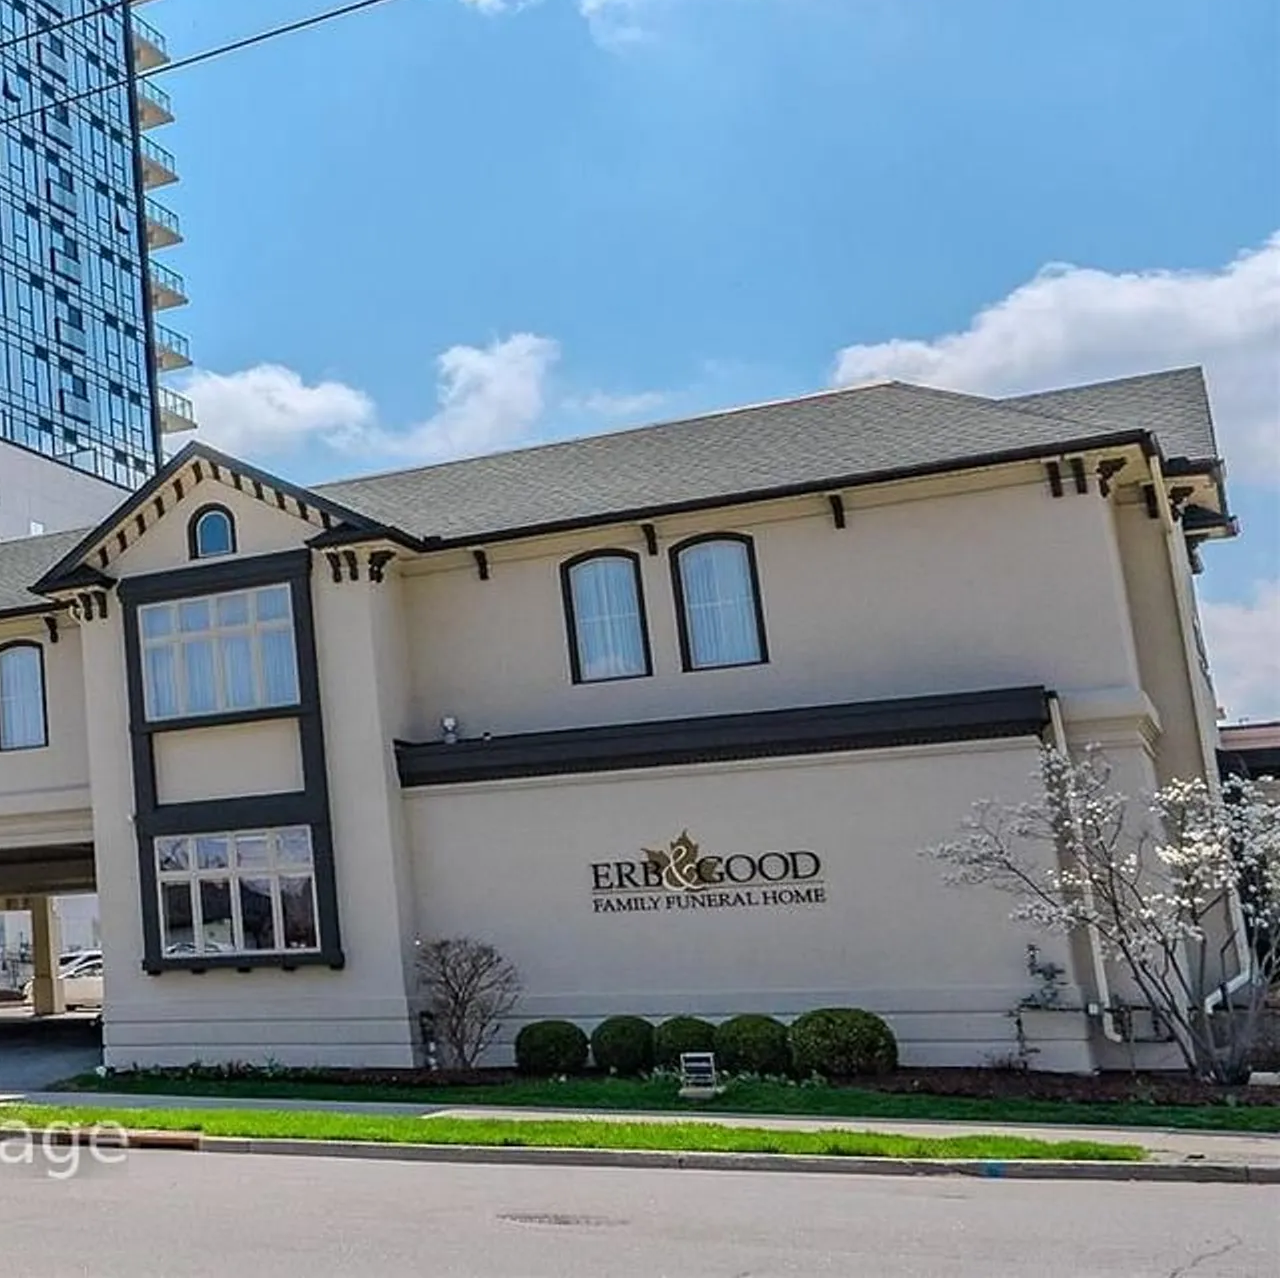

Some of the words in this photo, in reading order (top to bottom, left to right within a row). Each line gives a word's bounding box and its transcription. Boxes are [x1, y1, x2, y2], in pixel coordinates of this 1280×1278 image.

[590, 861, 663, 890] ERB
[662, 845, 706, 891] &
[695, 851, 821, 884] GOOD
[592, 896, 660, 913] FAMILY
[666, 891, 759, 910] FUNERAL
[762, 887, 826, 905] HOME
